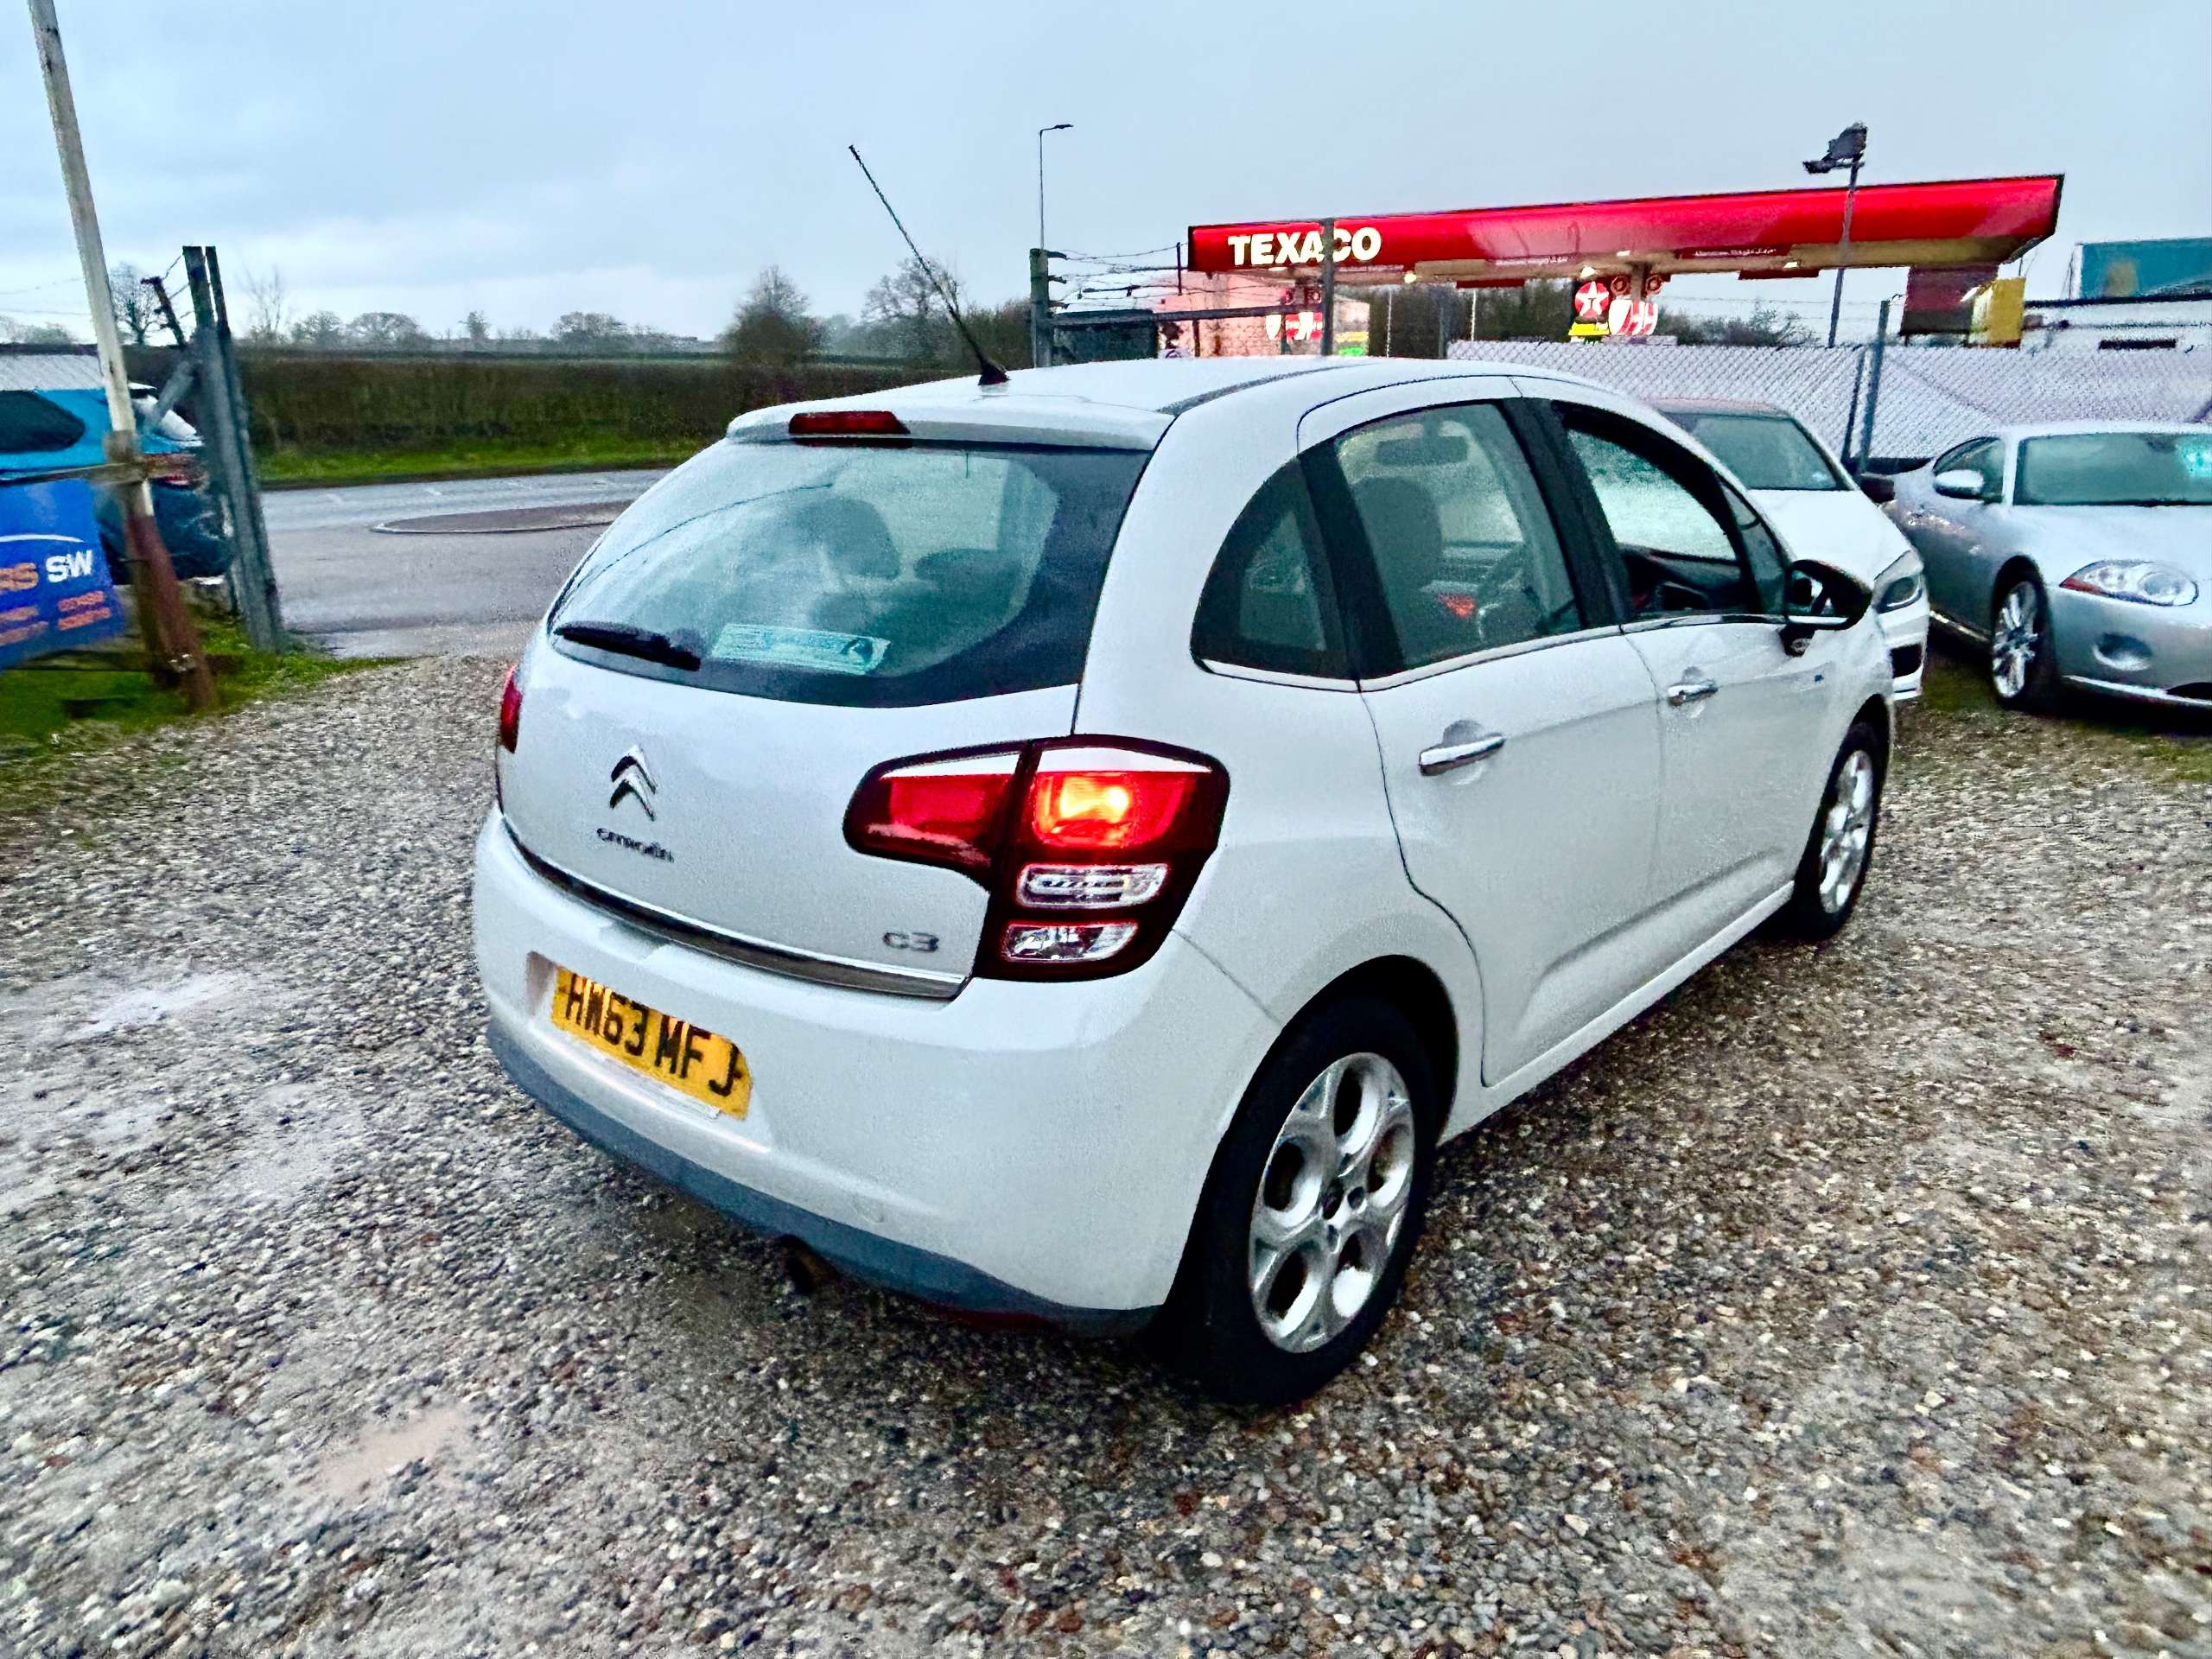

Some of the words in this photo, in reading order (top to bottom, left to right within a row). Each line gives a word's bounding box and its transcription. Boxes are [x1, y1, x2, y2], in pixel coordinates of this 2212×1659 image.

[1228, 226, 1382, 265] TEXACO
[46, 550, 92, 582] SW
[882, 931, 939, 953] C3
